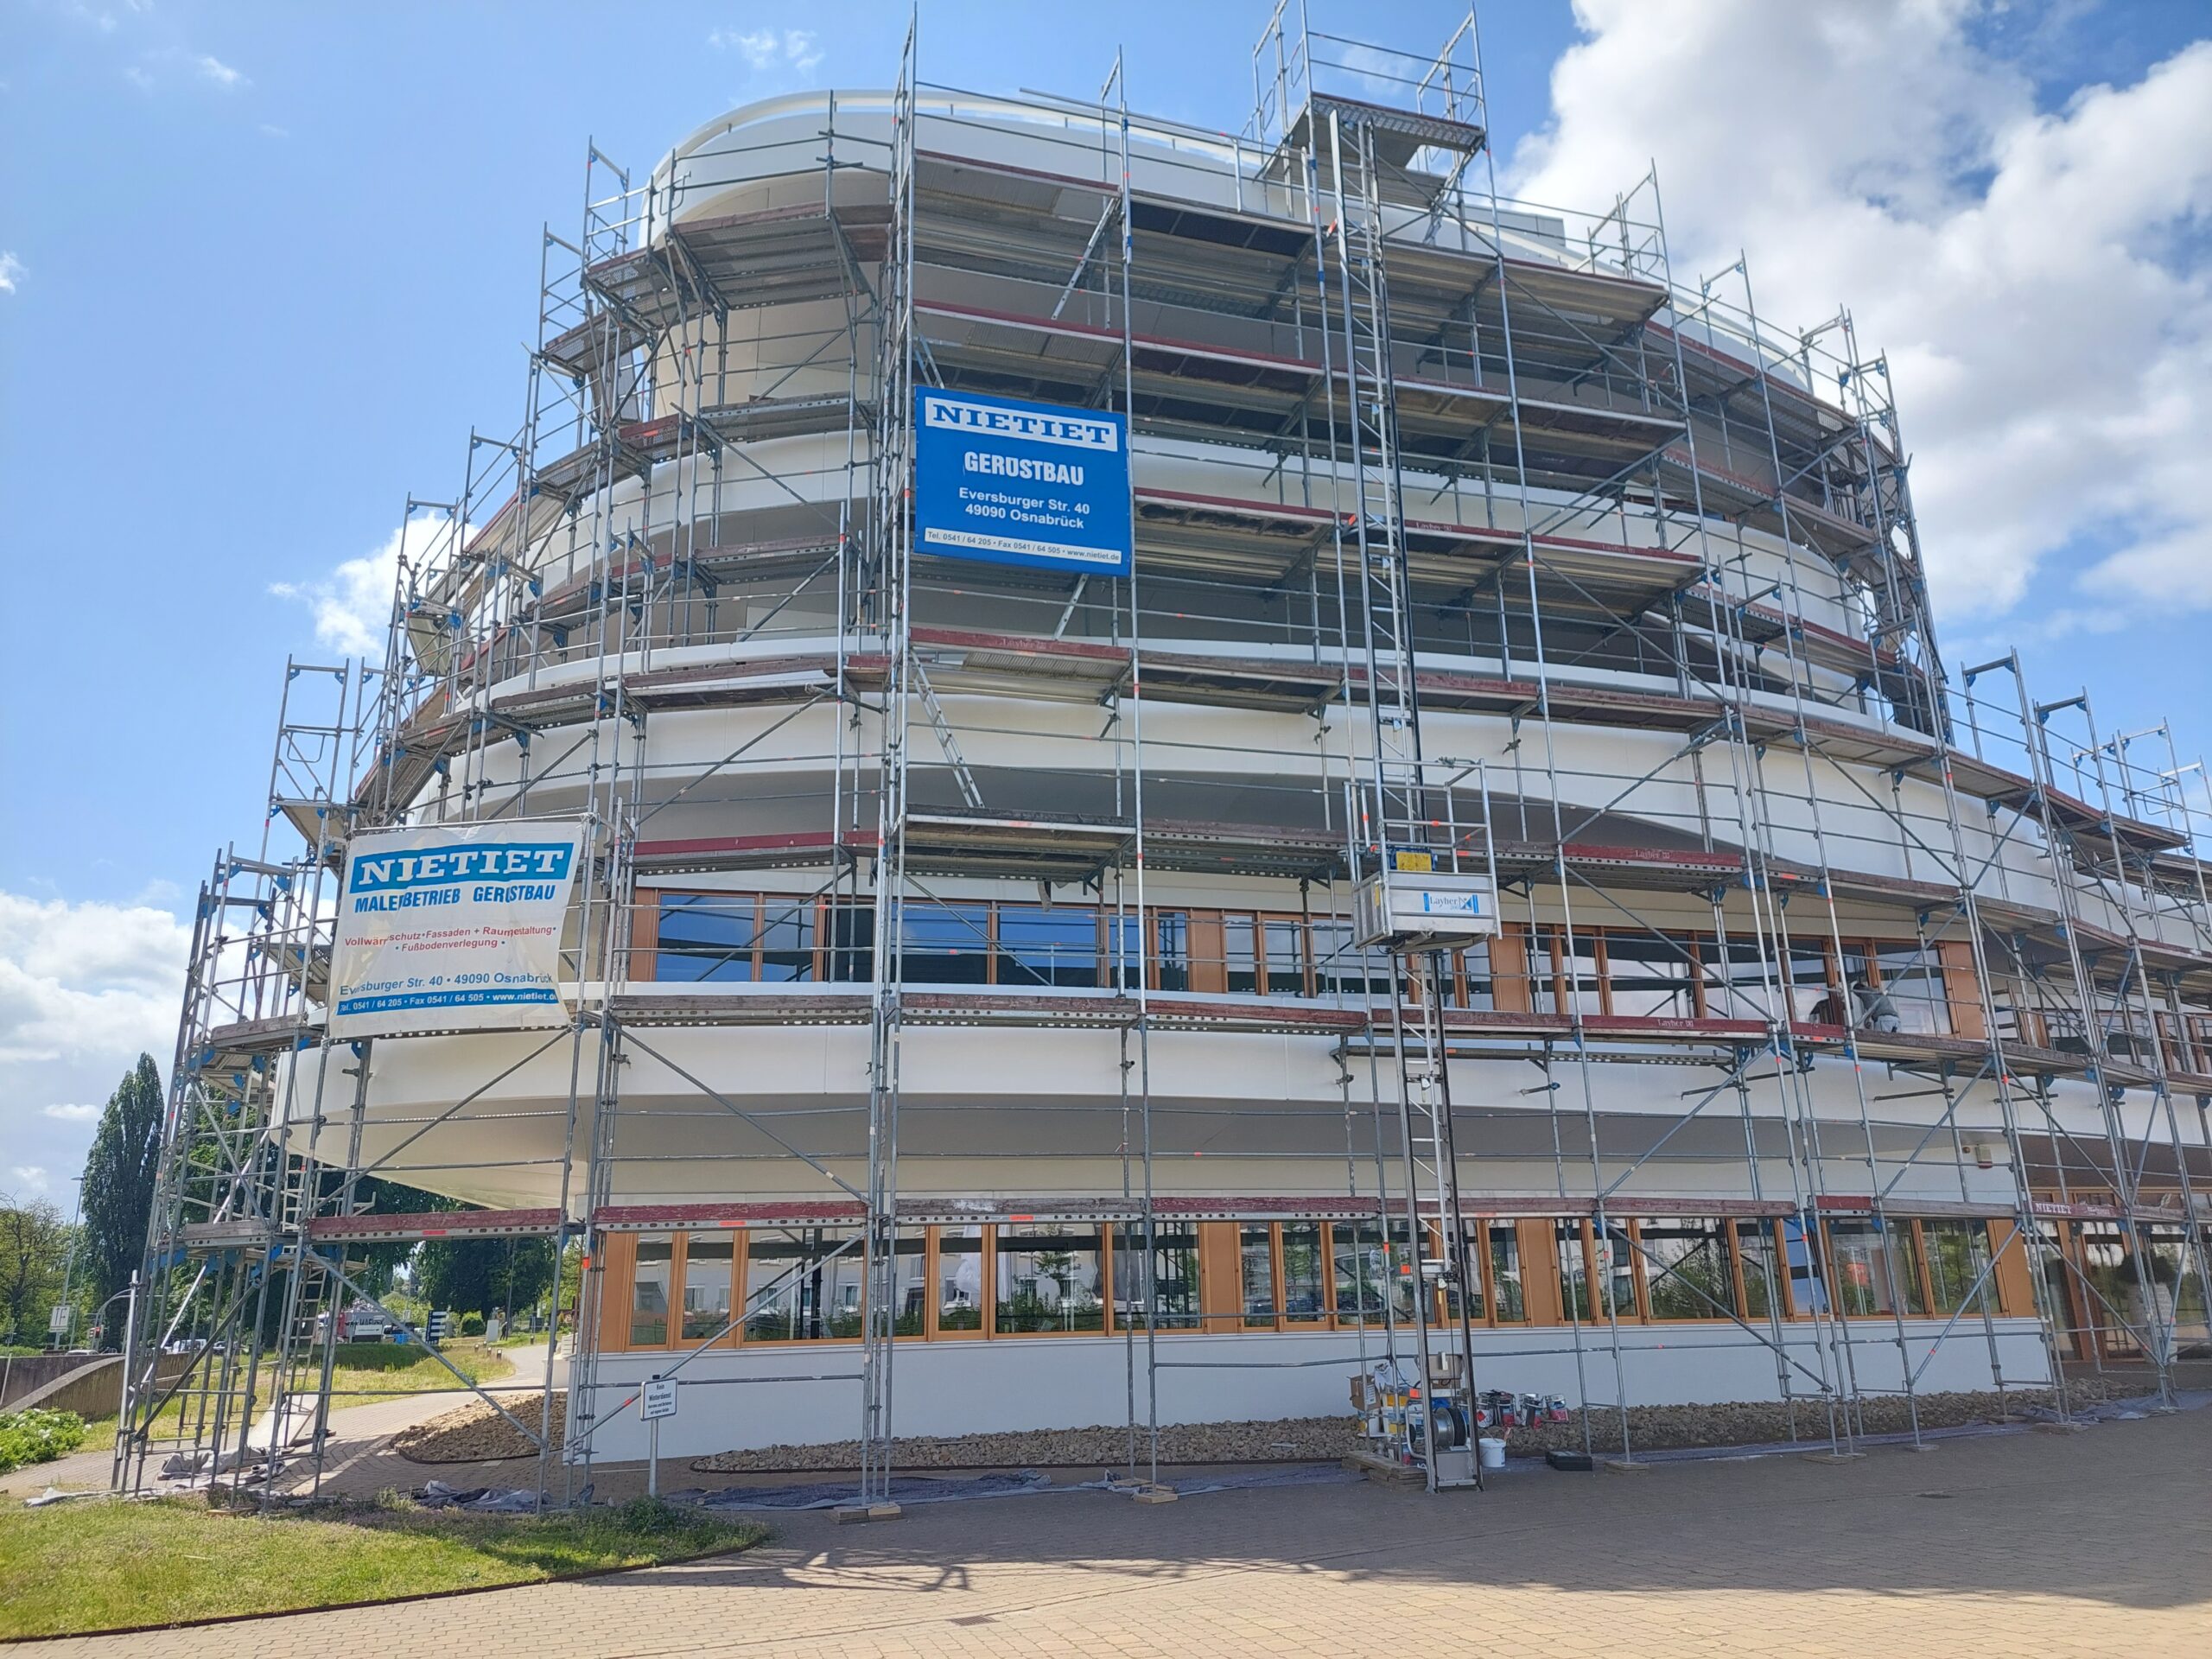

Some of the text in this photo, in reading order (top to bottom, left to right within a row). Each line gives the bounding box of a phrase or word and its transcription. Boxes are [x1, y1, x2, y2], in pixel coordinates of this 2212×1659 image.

[933, 404, 1110, 444] NIETIET
[959, 486, 1090, 515] Eversburger Str. 40
[965, 503, 1084, 529] 49090 Osnabrück
[927, 531, 941, 540] Tel.
[943, 532, 961, 543] 0541
[978, 537, 992, 546] 205
[998, 540, 1012, 549] Fax
[1067, 549, 1120, 561] www.nietiet.de
[359, 850, 564, 885] NIETIET
[1430, 895, 1459, 907] Layher
[345, 932, 422, 947] Vollwärschutz
[425, 928, 471, 939] Fassaden
[401, 938, 498, 952] Fußbodenverlegung
[340, 971, 553, 995] Evsburger Str. 40 49090 Osnabrück
[353, 1001, 370, 1010] 0541
[377, 1000, 386, 1008] 64
[387, 997, 403, 1007] 205
[410, 996, 424, 1005] Fax
[426, 995, 448, 1004] 0541
[454, 994, 466, 1002] 64
[467, 993, 485, 1002] 505
[493, 991, 557, 1001] www.nietiet.d
[2035, 1202, 2072, 1215] NIETIET
